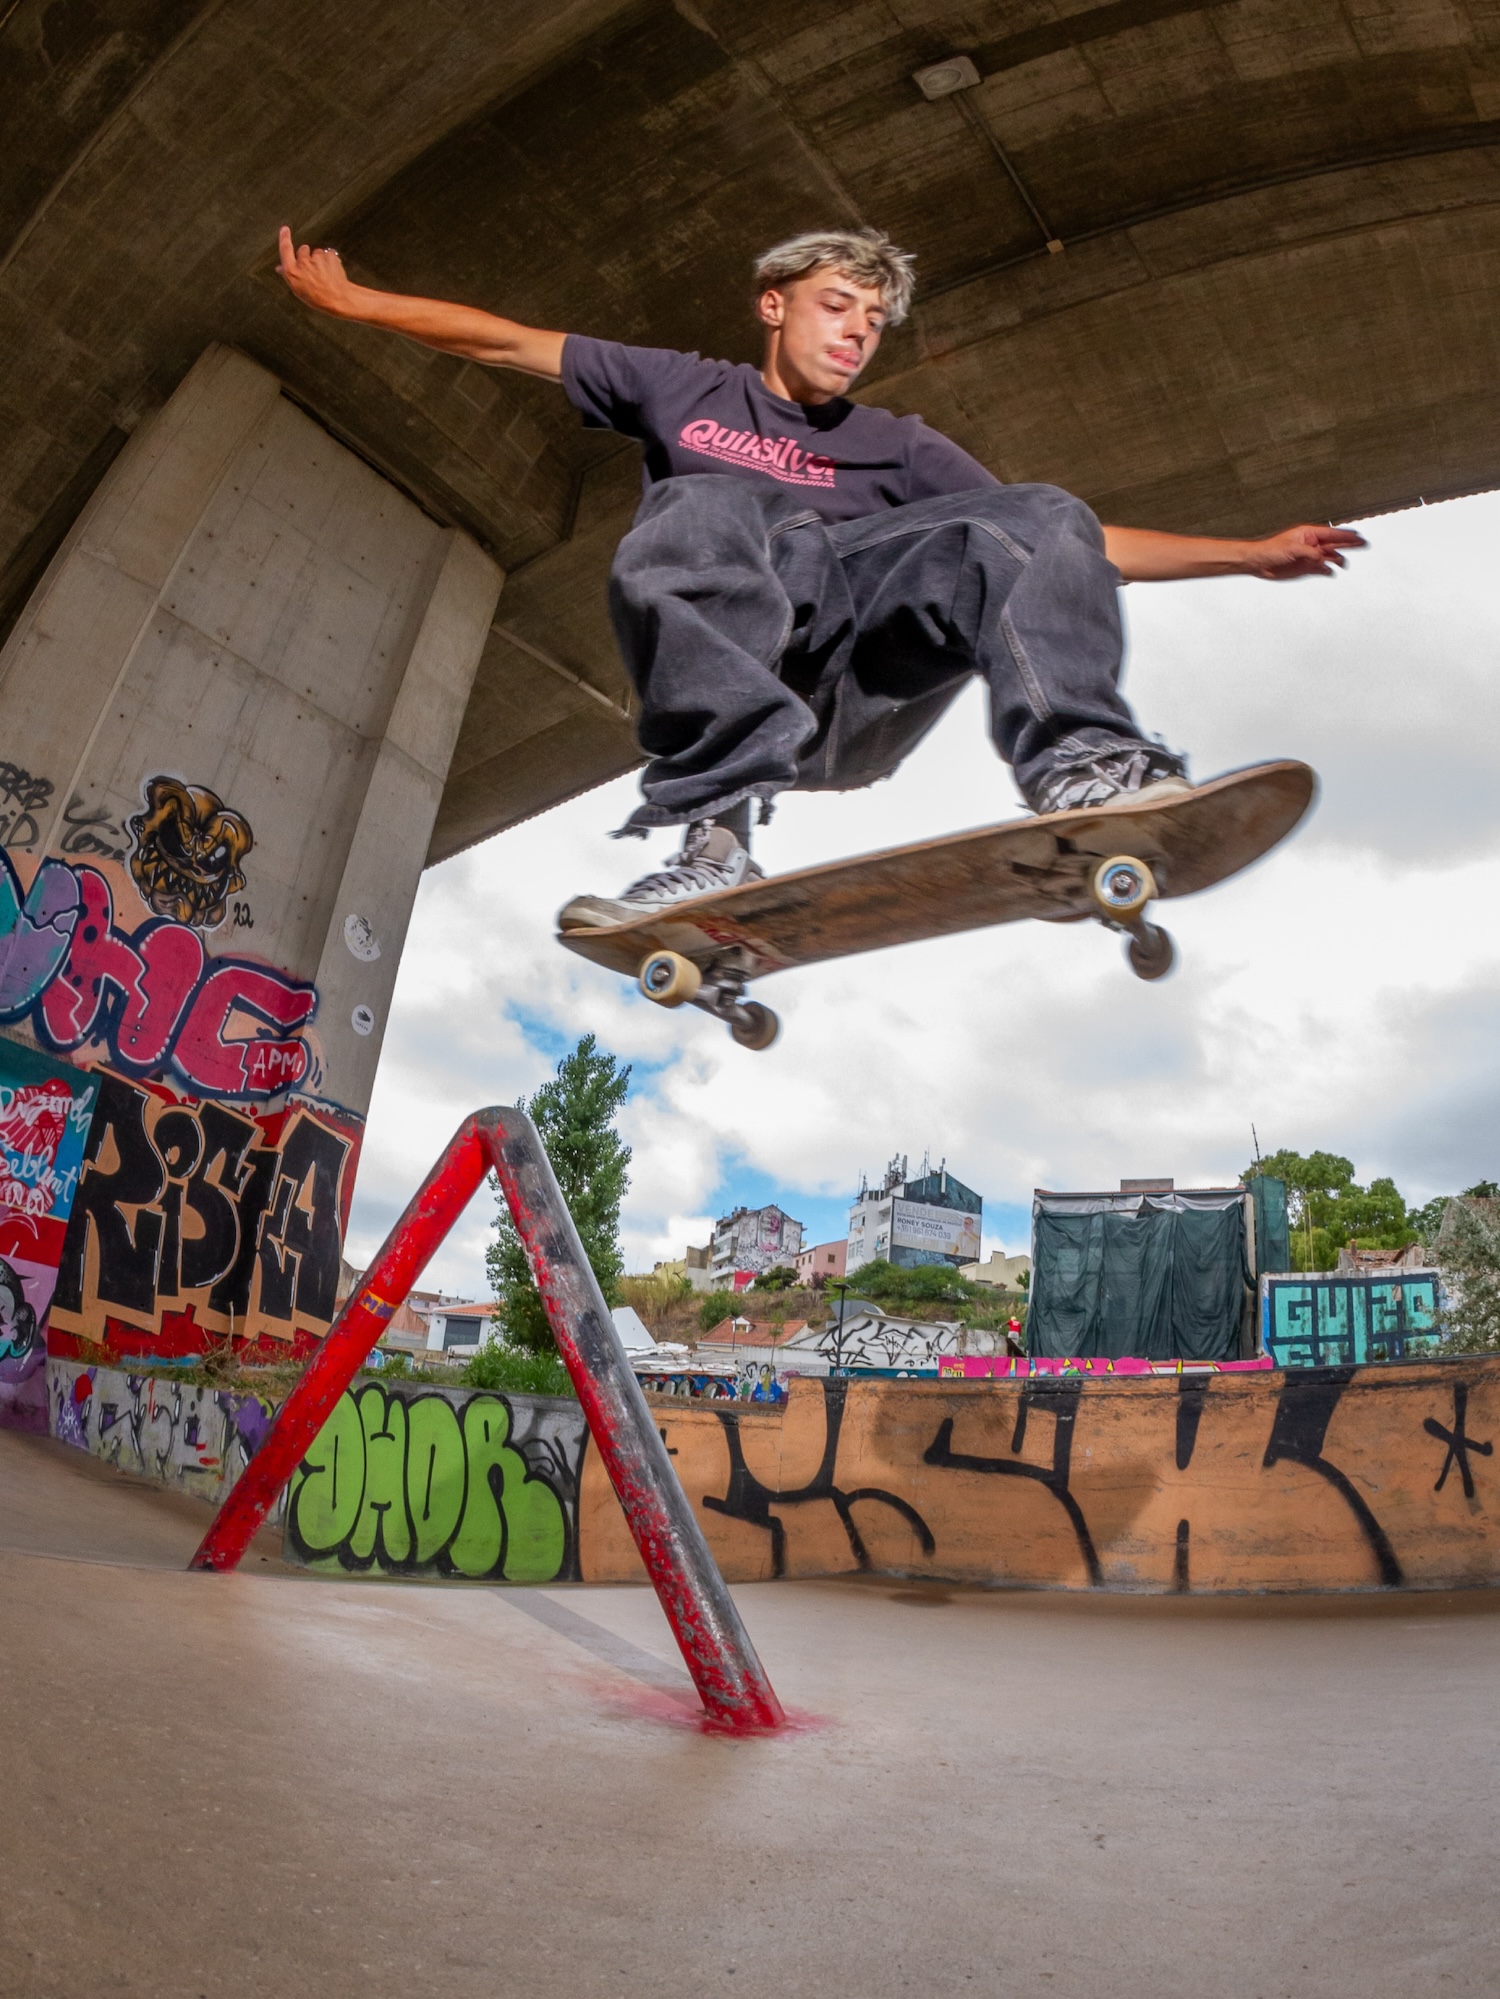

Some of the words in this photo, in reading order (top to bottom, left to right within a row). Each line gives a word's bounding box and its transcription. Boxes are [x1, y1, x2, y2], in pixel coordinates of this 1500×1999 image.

[680, 419, 836, 476] Quiksilver
[233, 901, 254, 929] 22
[897, 1217, 920, 1226] RONEY
[921, 1221, 944, 1231] SOUZA
